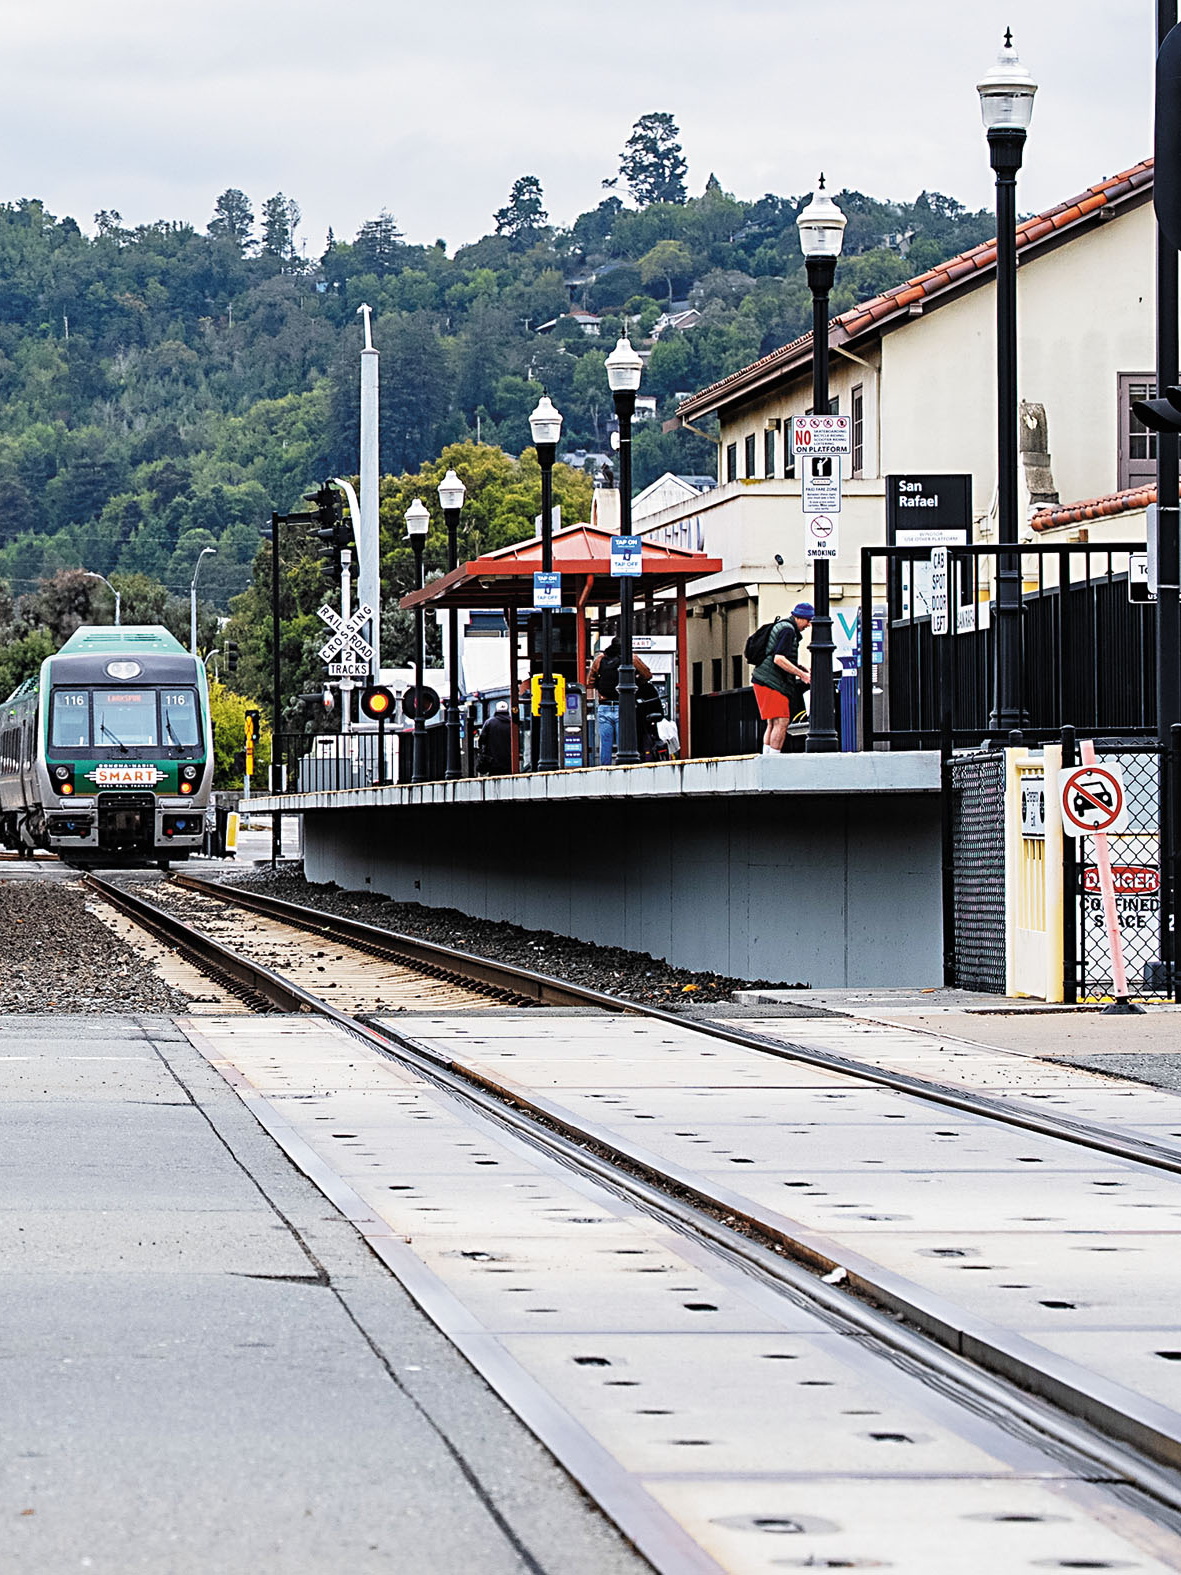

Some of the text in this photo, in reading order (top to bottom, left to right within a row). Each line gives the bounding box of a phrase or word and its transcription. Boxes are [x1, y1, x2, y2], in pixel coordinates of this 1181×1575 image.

[796, 430, 811, 445] NO
[899, 480, 922, 492] San
[899, 495, 938, 507] Rafael
[933, 615, 946, 632] LEFT
[321, 608, 372, 657] RAIL ROAD
[322, 606, 372, 658] CROSSING
[346, 652, 352, 661] 2
[331, 665, 366, 674] TRACKS
[65, 695, 84, 705] 116
[166, 695, 185, 705] 116
[99, 771, 153, 781] SMART
[1085, 872, 1156, 888] DNGER
[1080, 898, 1159, 911] COFINED
[1094, 915, 1146, 928] SACE
